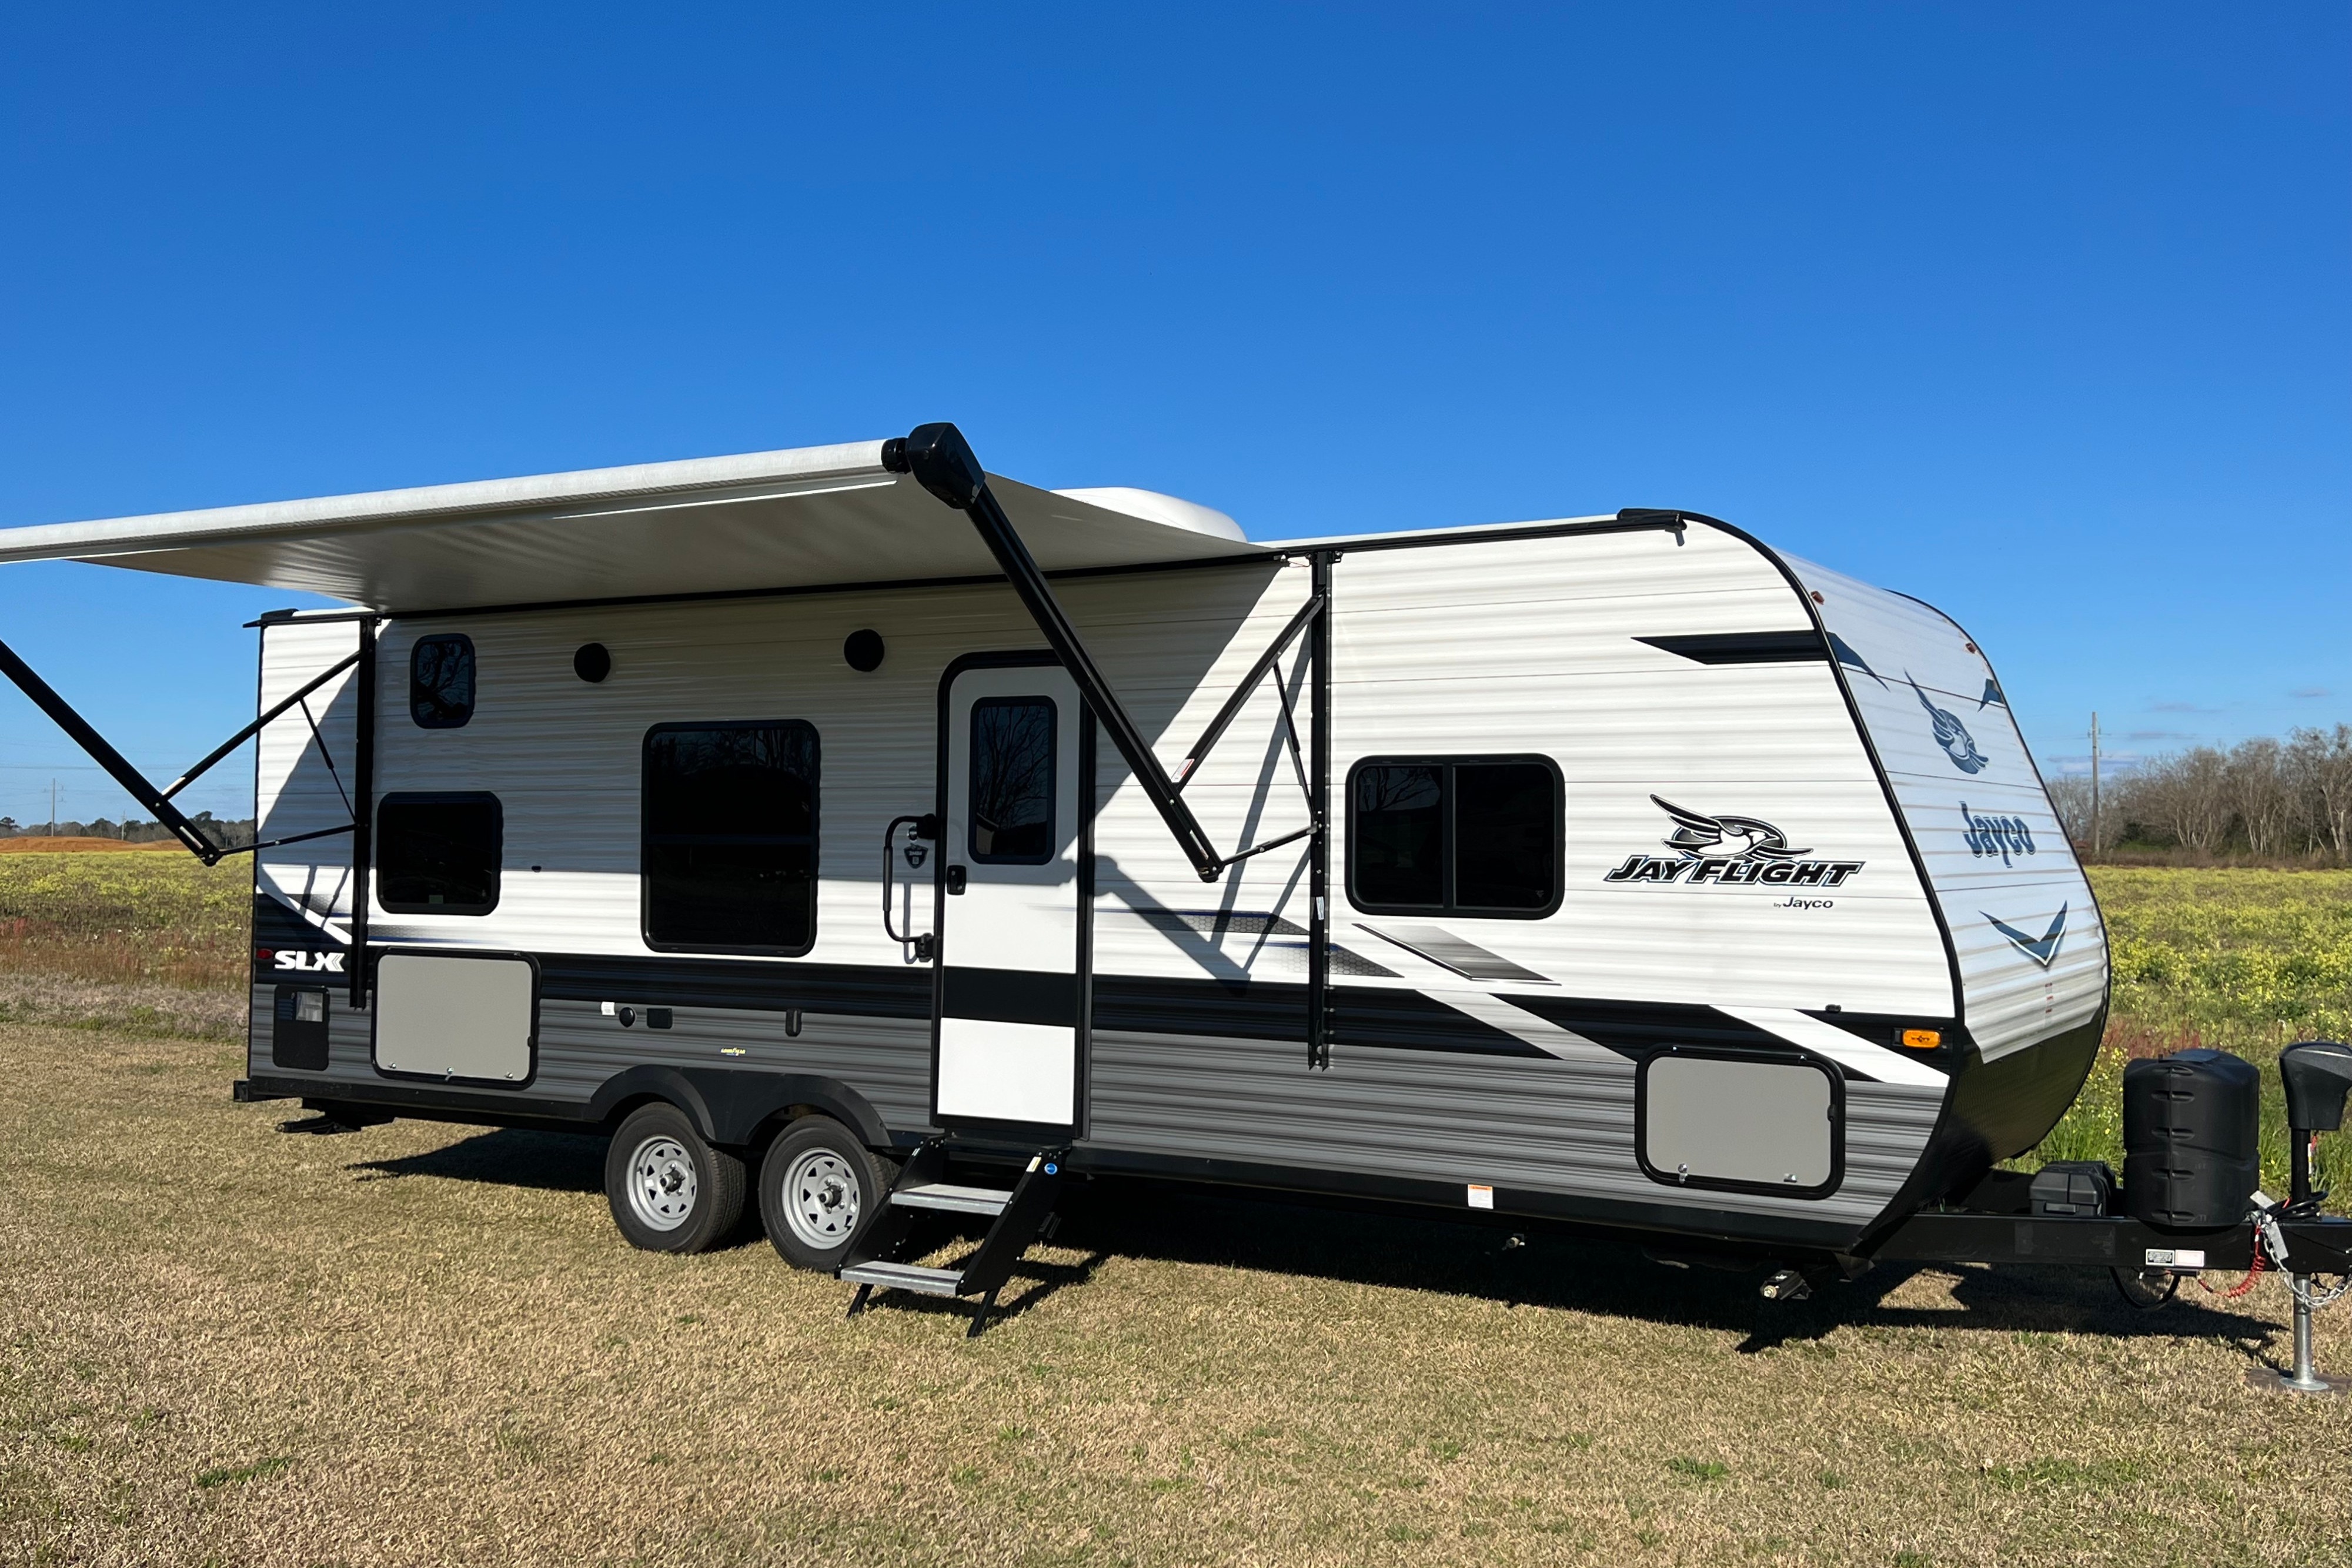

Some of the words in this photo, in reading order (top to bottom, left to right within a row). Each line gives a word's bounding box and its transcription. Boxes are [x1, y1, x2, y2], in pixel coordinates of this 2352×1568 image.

[1959, 801, 2036, 868] Jayco
[1605, 855, 1699, 882] JAY
[1685, 857, 1865, 887] FLIGHT
[1783, 897, 1833, 910] Jayco
[275, 950, 345, 972] SLX
